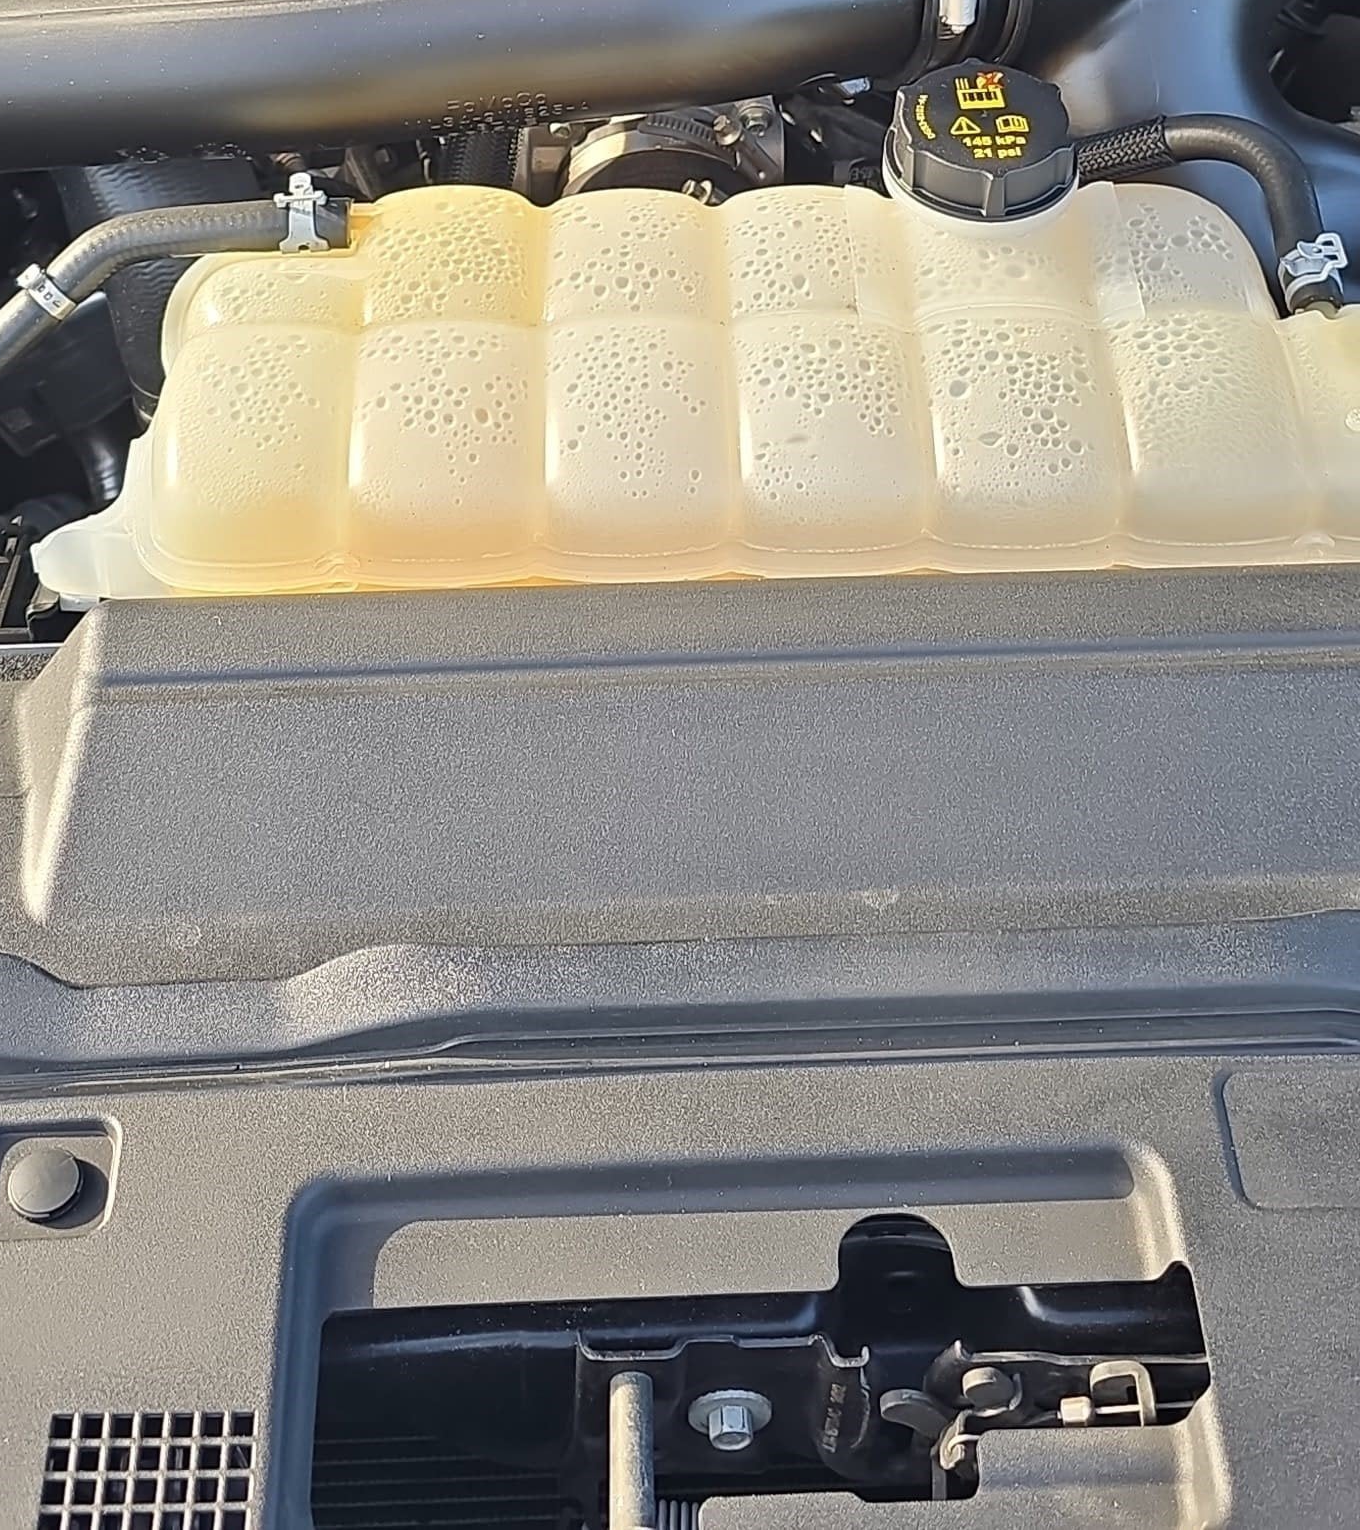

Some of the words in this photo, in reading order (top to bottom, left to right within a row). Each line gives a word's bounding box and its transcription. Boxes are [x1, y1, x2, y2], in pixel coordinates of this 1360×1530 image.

[995, 135, 1027, 146] kPa
[974, 148, 993, 158] 21
[997, 147, 1022, 158] psi
